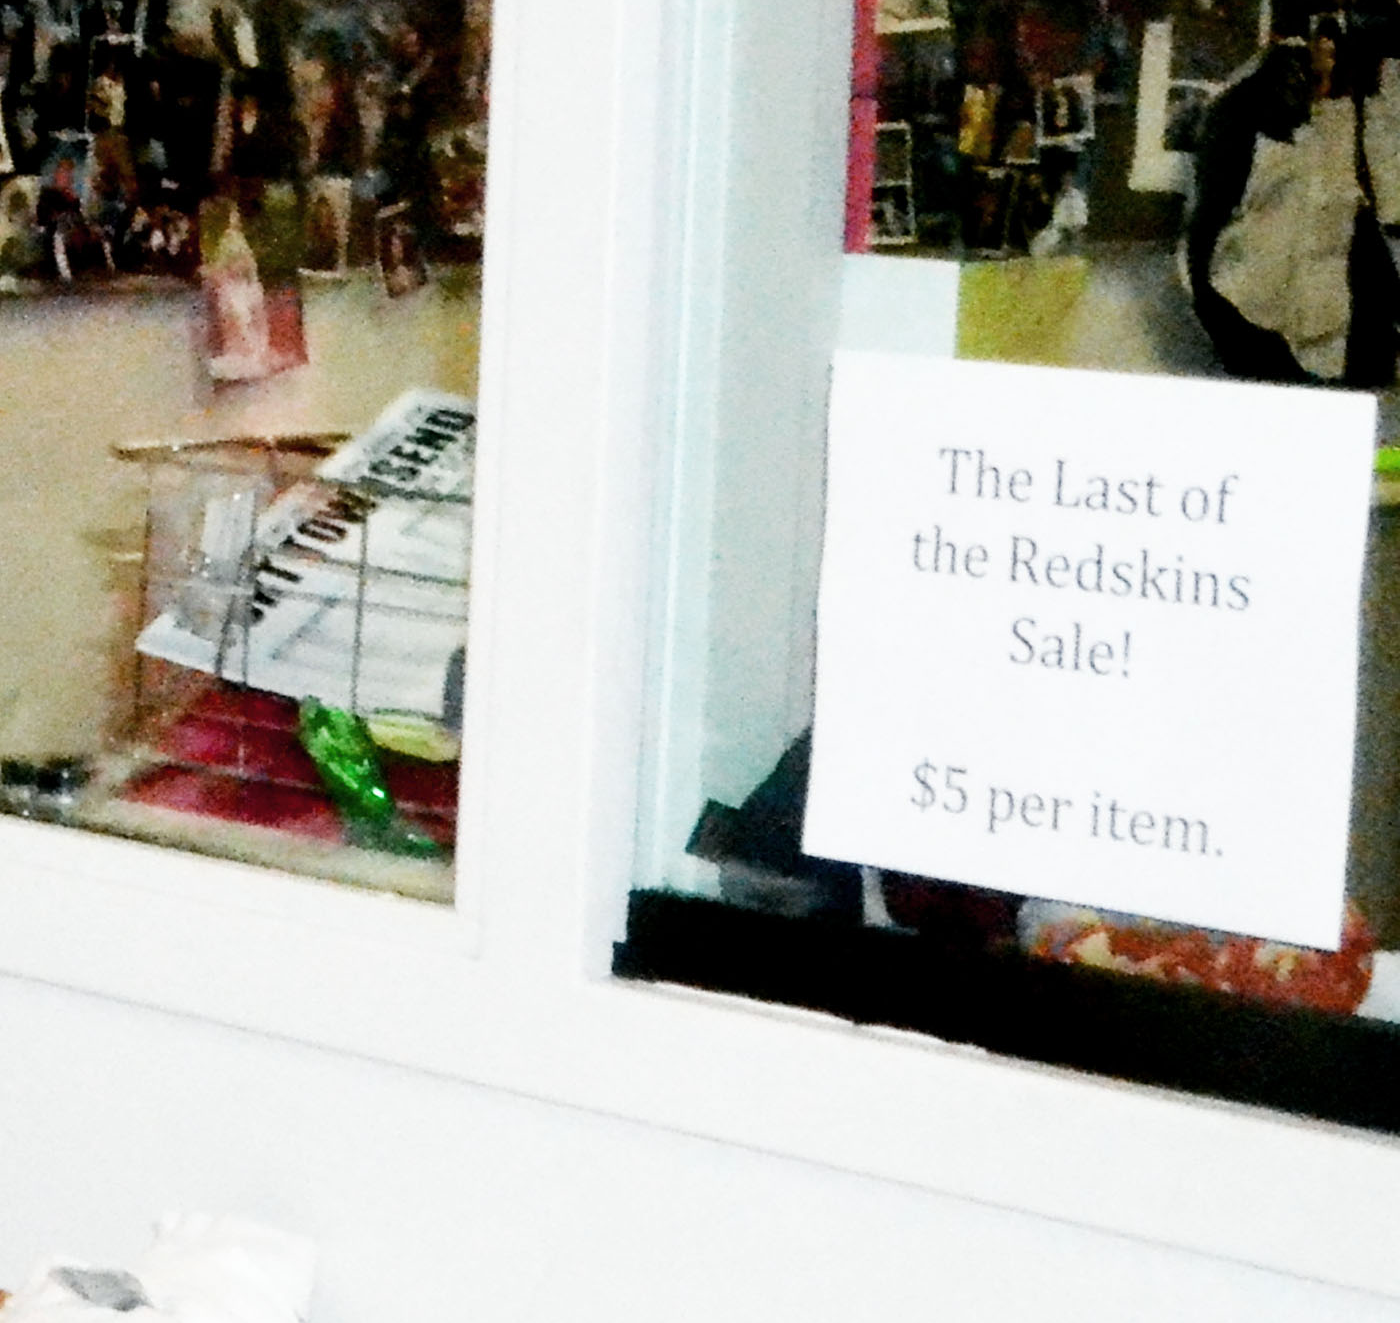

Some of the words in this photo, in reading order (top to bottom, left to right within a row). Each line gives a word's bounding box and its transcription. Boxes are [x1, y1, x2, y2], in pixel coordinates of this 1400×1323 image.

[939, 447, 1033, 503] The
[1055, 459, 1161, 517] Last
[1180, 474, 1239, 524] of
[913, 524, 989, 578] the
[1010, 535, 1250, 610] Redskins
[1009, 616, 1132, 678] Sale!
[910, 759, 968, 814] $5
[988, 784, 1073, 834] per
[1090, 791, 1224, 857] item.
